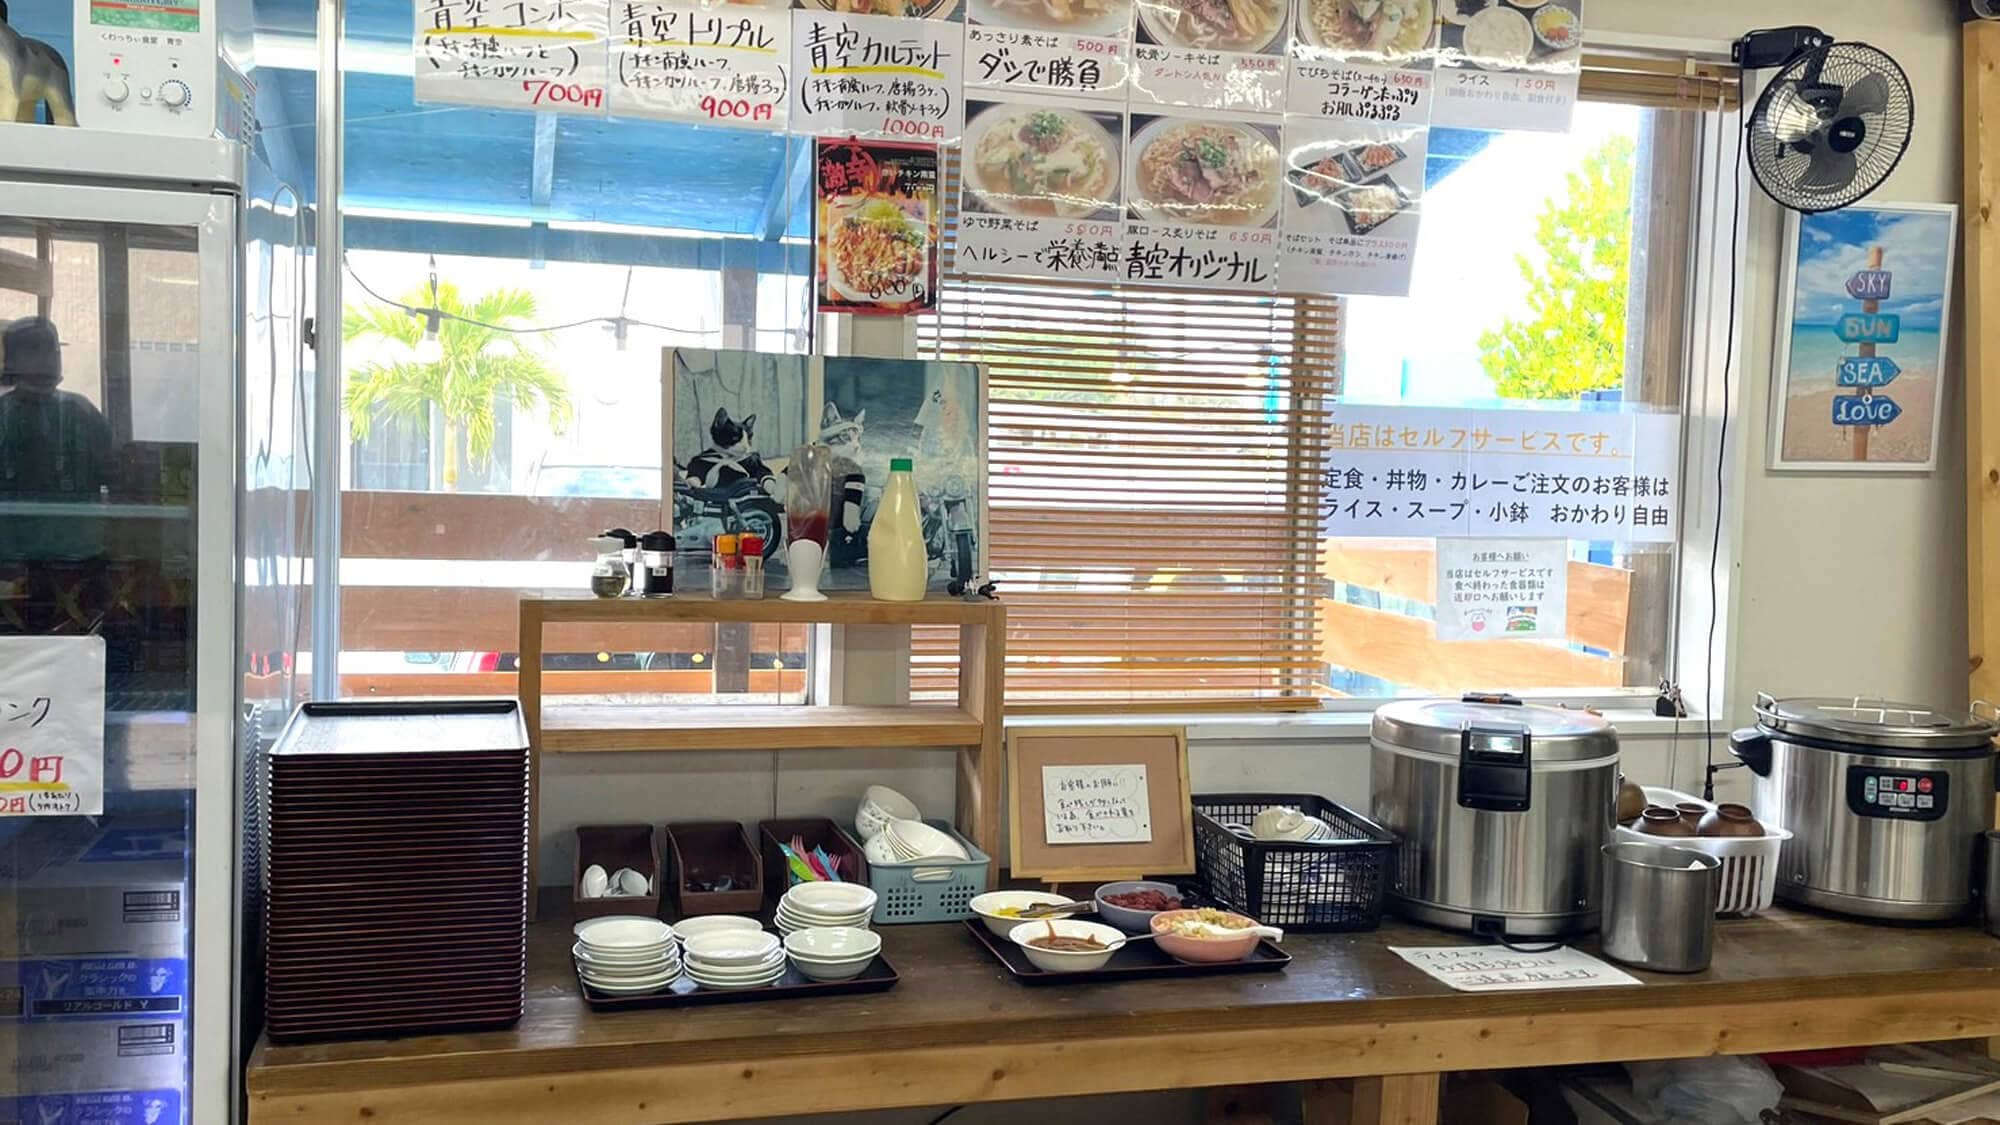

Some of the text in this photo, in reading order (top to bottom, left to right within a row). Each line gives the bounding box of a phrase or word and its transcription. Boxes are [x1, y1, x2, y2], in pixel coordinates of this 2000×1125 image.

[621, 3, 774, 48] 青空トリプル
[804, 22, 951, 72] 青空カルテット
[969, 30, 1119, 55] あっさり素そば 500円
[1136, 48, 1220, 65] 軟骨ソーキそば
[979, 48, 1101, 92] ダシで勝負
[1457, 73, 1556, 91] ライス 150円
[523, 80, 602, 108] 700円
[1328, 82, 1419, 105] コラーゲンたっぷり
[700, 95, 773, 120] 900円
[1321, 101, 1400, 120] お肌ぷるぷる
[882, 118, 944, 138] 1000円
[963, 217, 1040, 231] ゆで野菜そば
[1127, 225, 1273, 244] 豚ロース炙りそば 650円
[963, 239, 1119, 271] ヘルシーで栄養満点
[1125, 240, 1267, 282] 青空オリジナル
[1856, 272, 1888, 293] SKY
[1843, 363, 1884, 384] SEA
[1328, 423, 1618, 456] 当店はセルフサービスです。
[1326, 467, 1669, 497] 定食・丼物・カレーご注文のお客様は
[1325, 499, 1668, 526] ライス・スープ・小鉢 おかわり自由
[1446, 568, 1553, 579] 当店はセルフサービスです
[139, 1000, 149, 1010] Y
